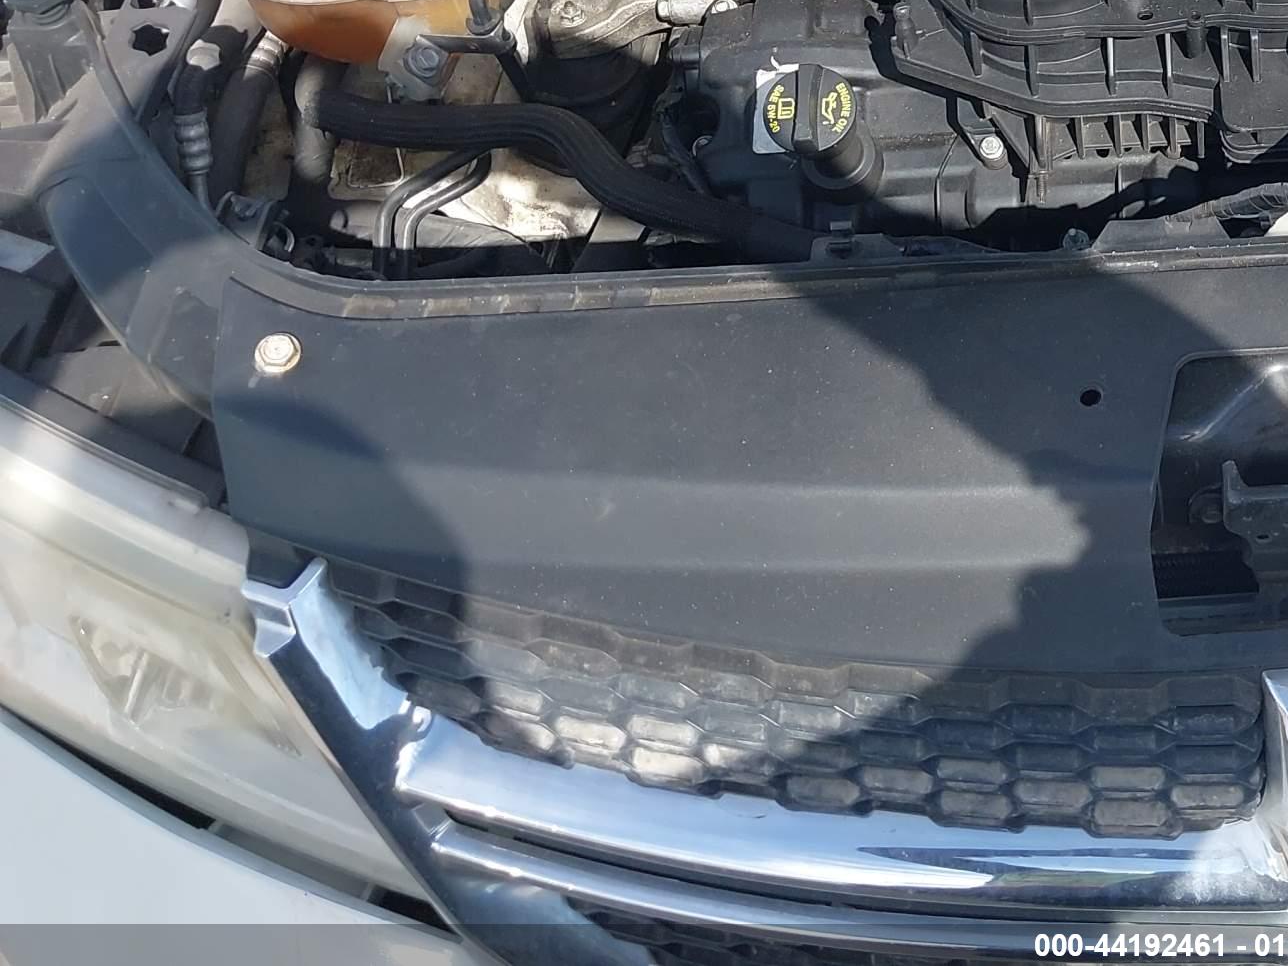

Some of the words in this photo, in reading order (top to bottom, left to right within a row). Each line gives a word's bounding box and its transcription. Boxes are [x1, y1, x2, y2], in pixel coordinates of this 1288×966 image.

[769, 84, 785, 103] SAE
[836, 83, 852, 117] ENGINE
[767, 104, 780, 133] 5W-20
[831, 118, 848, 133] OIL
